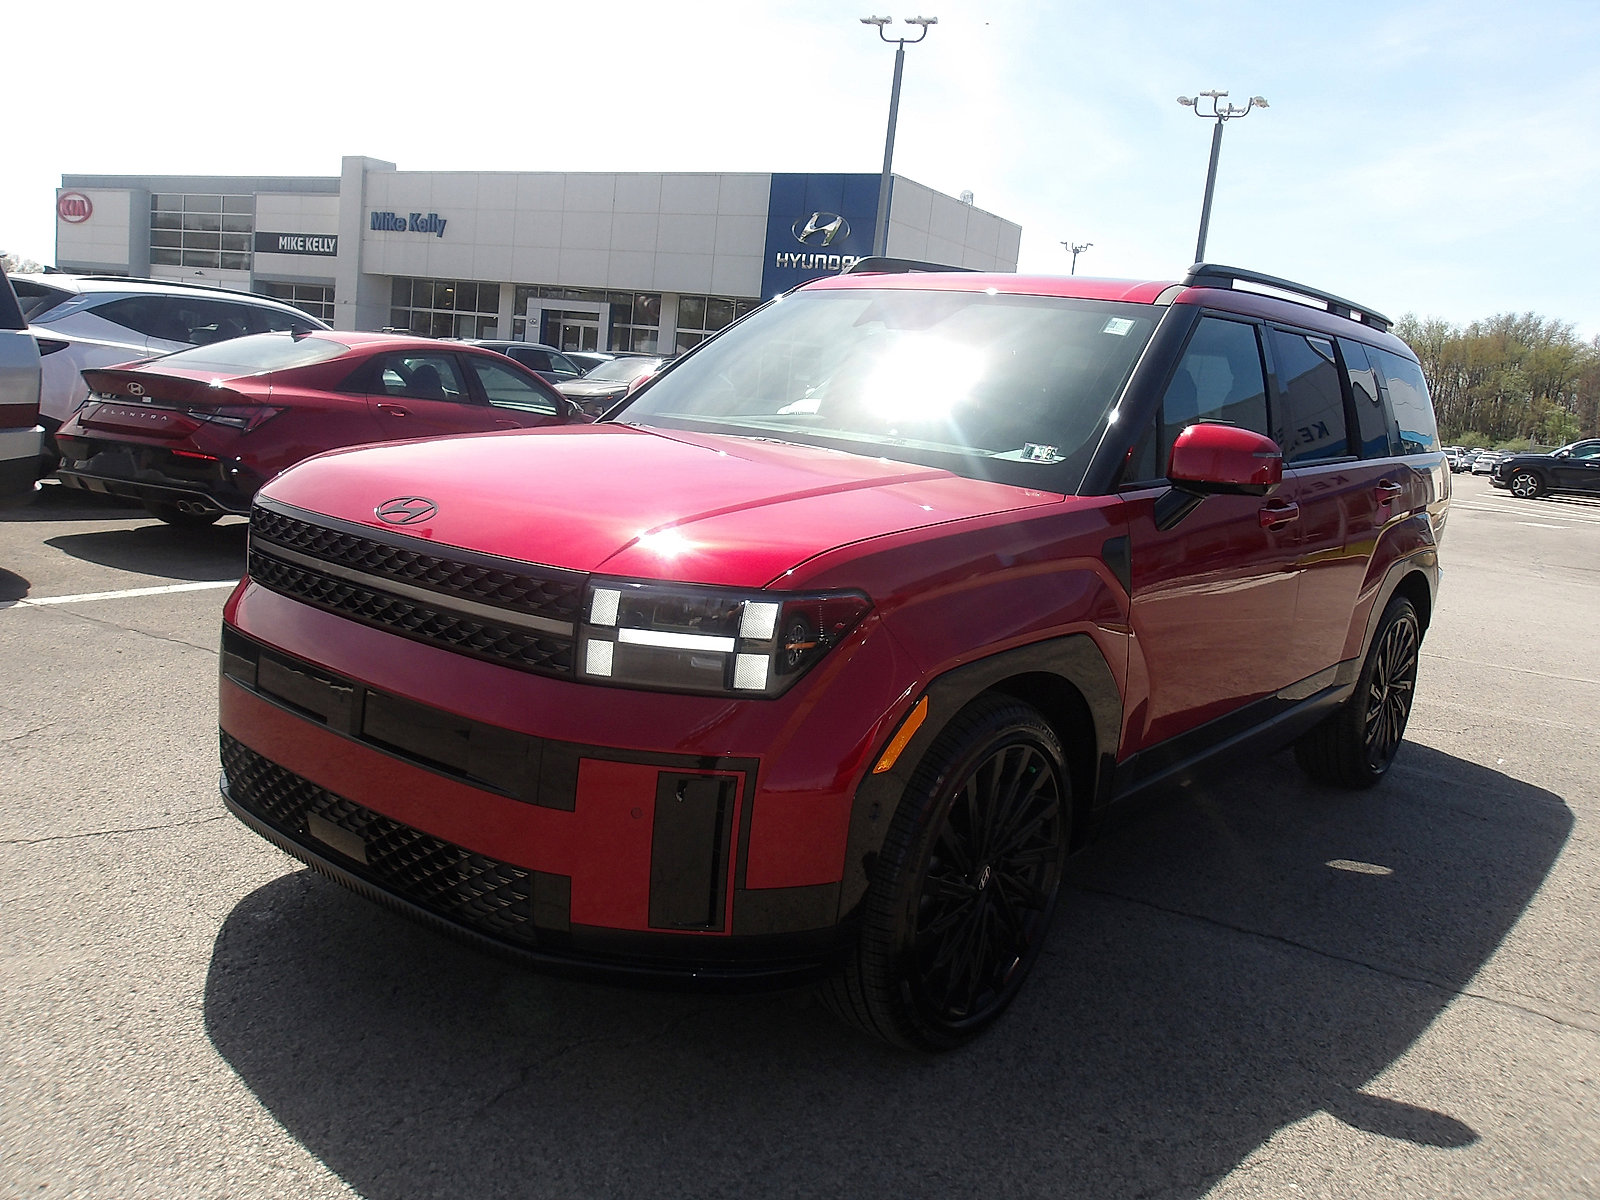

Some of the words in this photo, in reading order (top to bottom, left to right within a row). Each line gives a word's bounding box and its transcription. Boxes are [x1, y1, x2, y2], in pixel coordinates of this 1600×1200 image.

[370, 211, 407, 231] Mike
[408, 212, 447, 238] Kelly
[278, 236, 304, 251] MIKE
[305, 237, 336, 253] KELLY
[102, 408, 168, 421] ELANTRA
